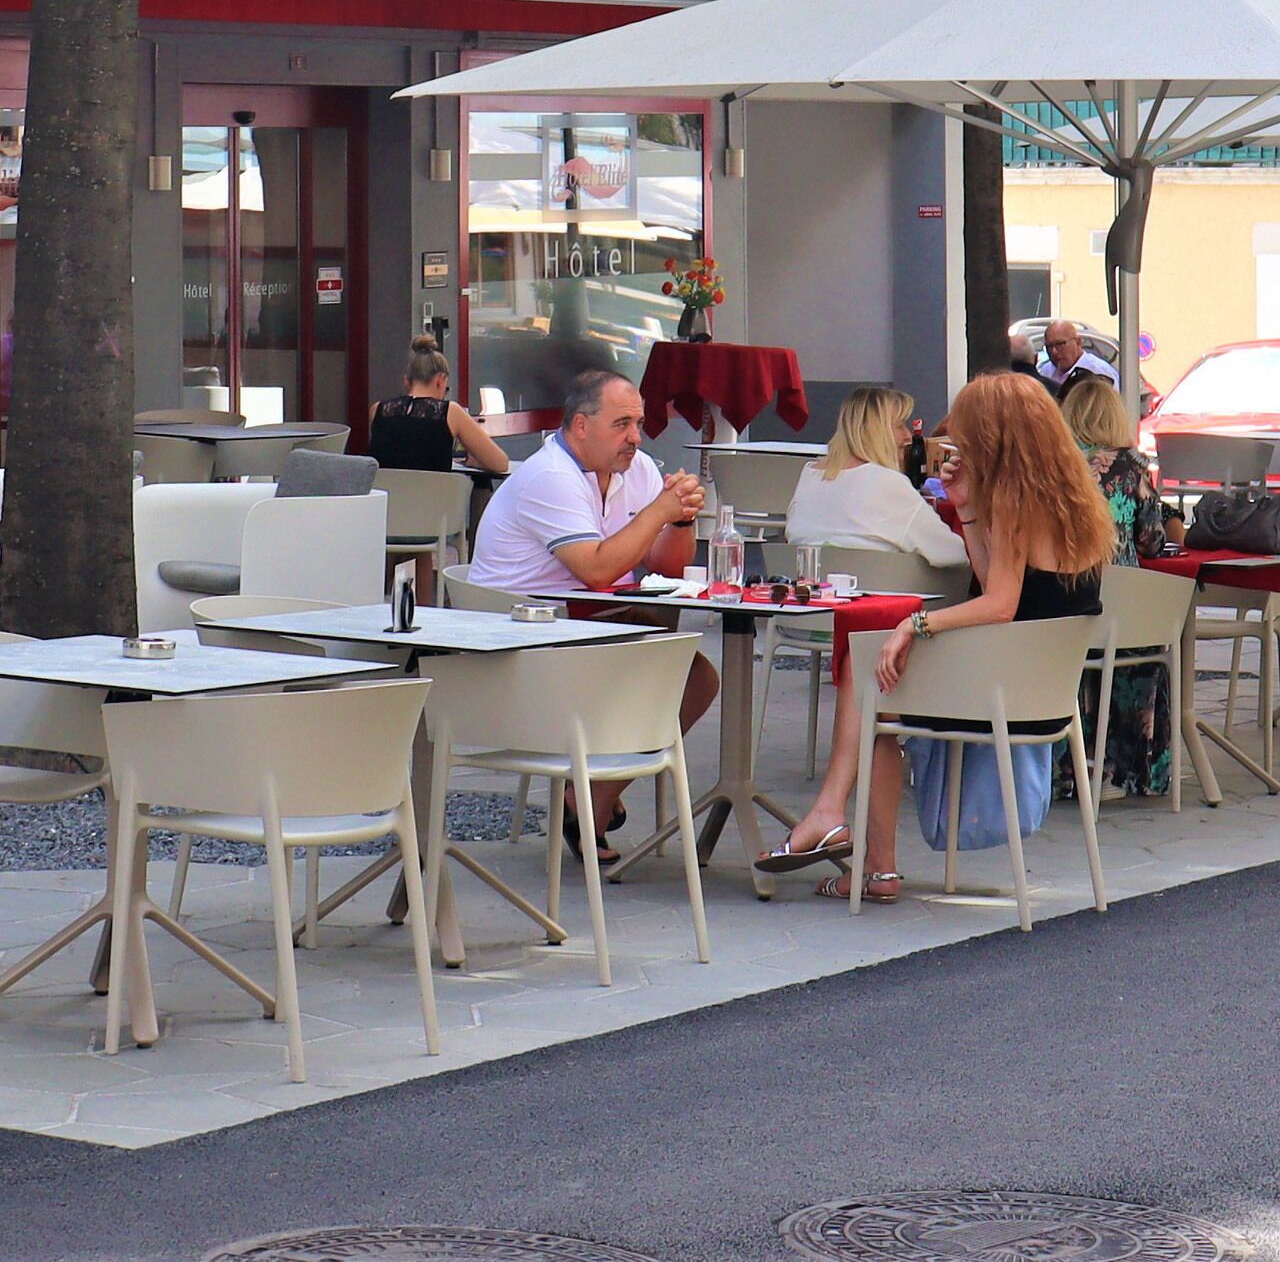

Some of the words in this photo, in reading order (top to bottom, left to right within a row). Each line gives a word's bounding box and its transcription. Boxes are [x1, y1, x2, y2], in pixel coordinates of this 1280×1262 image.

[557, 163, 594, 187] Hôtel
[597, 163, 628, 187] Elite
[545, 239, 635, 279] Hôtel
[183, 283, 212, 299] Hôtel
